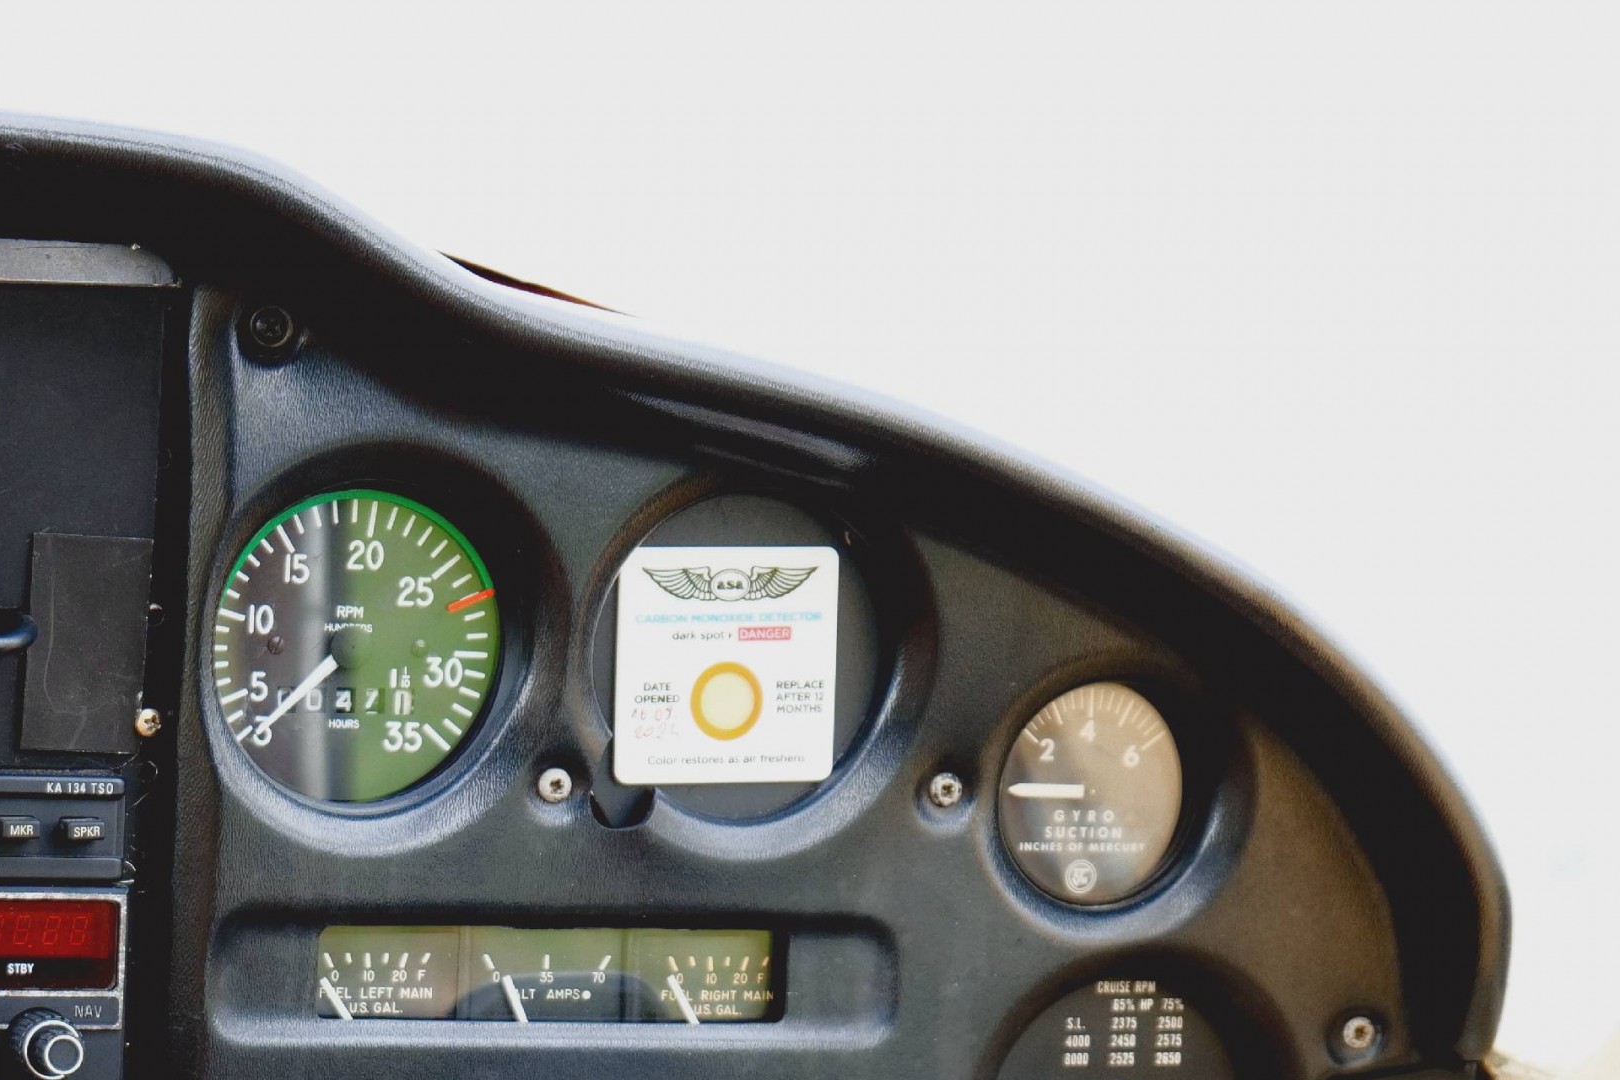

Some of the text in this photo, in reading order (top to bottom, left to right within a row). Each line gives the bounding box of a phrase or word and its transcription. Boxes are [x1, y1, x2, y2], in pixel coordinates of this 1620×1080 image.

[347, 541, 384, 570] 20
[284, 554, 309, 584] 15
[397, 577, 434, 607] 25
[337, 606, 363, 617] RPM
[248, 605, 273, 634] 10
[739, 629, 789, 640] DANGER
[424, 657, 463, 687] 30
[644, 683, 671, 691] DATE
[776, 681, 824, 689] REPLACE
[635, 695, 680, 703] OPENED
[328, 719, 359, 729] HOURS
[383, 722, 422, 751] 35
[1039, 739, 1054, 761] 2
[47, 783, 114, 794] KA 134 TSO
[10, 826, 33, 836] MKR
[74, 827, 100, 837] SPKR
[1045, 827, 1122, 838] SUCTION
[540, 971, 553, 983] 35
[593, 971, 606, 983] 70
[1097, 981, 1155, 992] CRUISE RPM
[361, 987, 433, 1000] LEFT MAIN
[546, 989, 580, 1000] AMPS
[74, 1006, 102, 1018] NAV
[1112, 1017, 1182, 1029] 2375 2500
